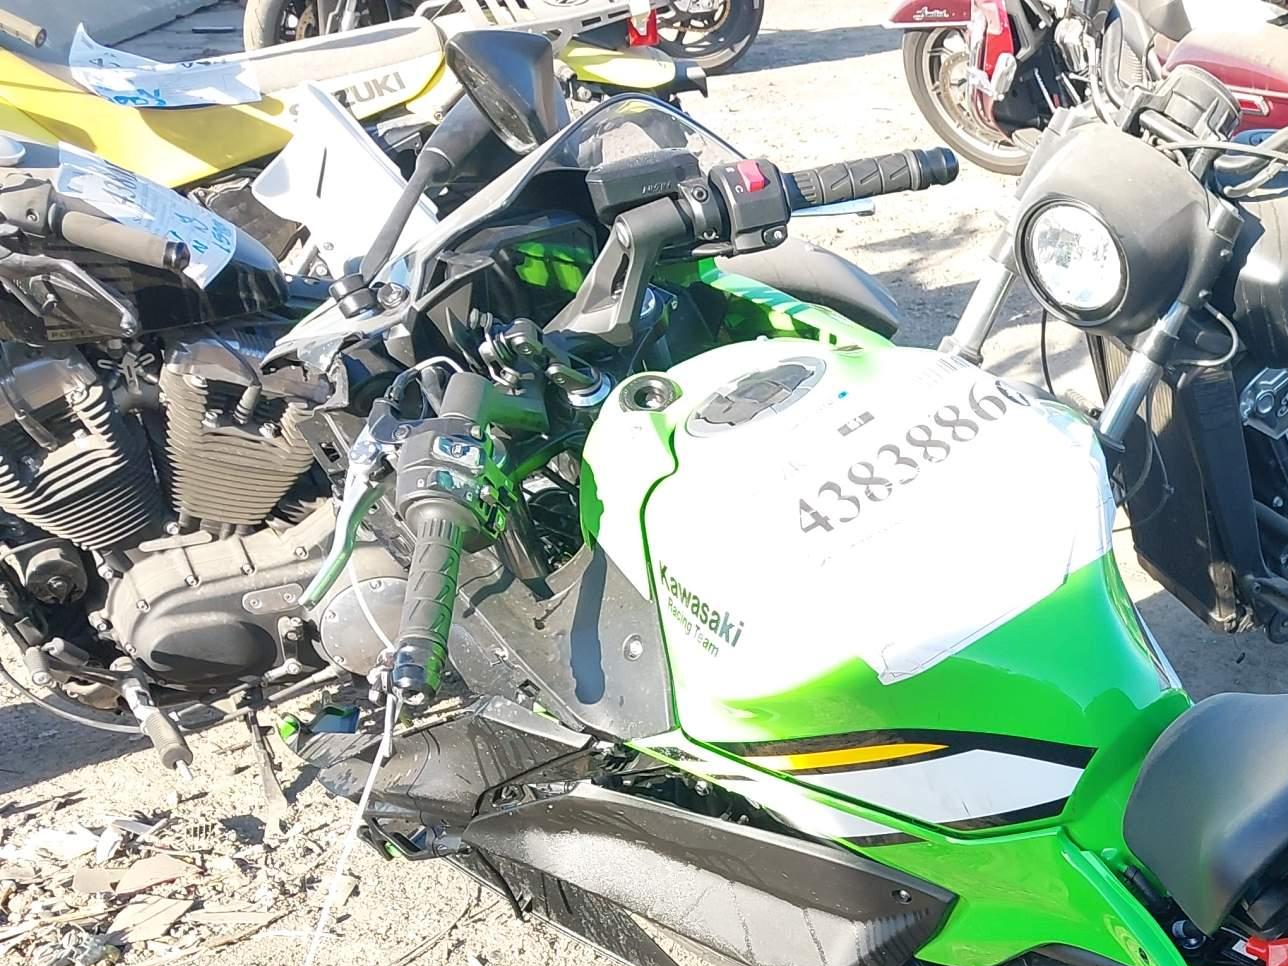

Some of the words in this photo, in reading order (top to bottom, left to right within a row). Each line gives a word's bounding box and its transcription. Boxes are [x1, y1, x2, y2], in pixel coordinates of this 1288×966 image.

[659, 559, 745, 648] Kawasaki
[667, 596, 693, 636] Racing
[693, 623, 720, 658] Team
